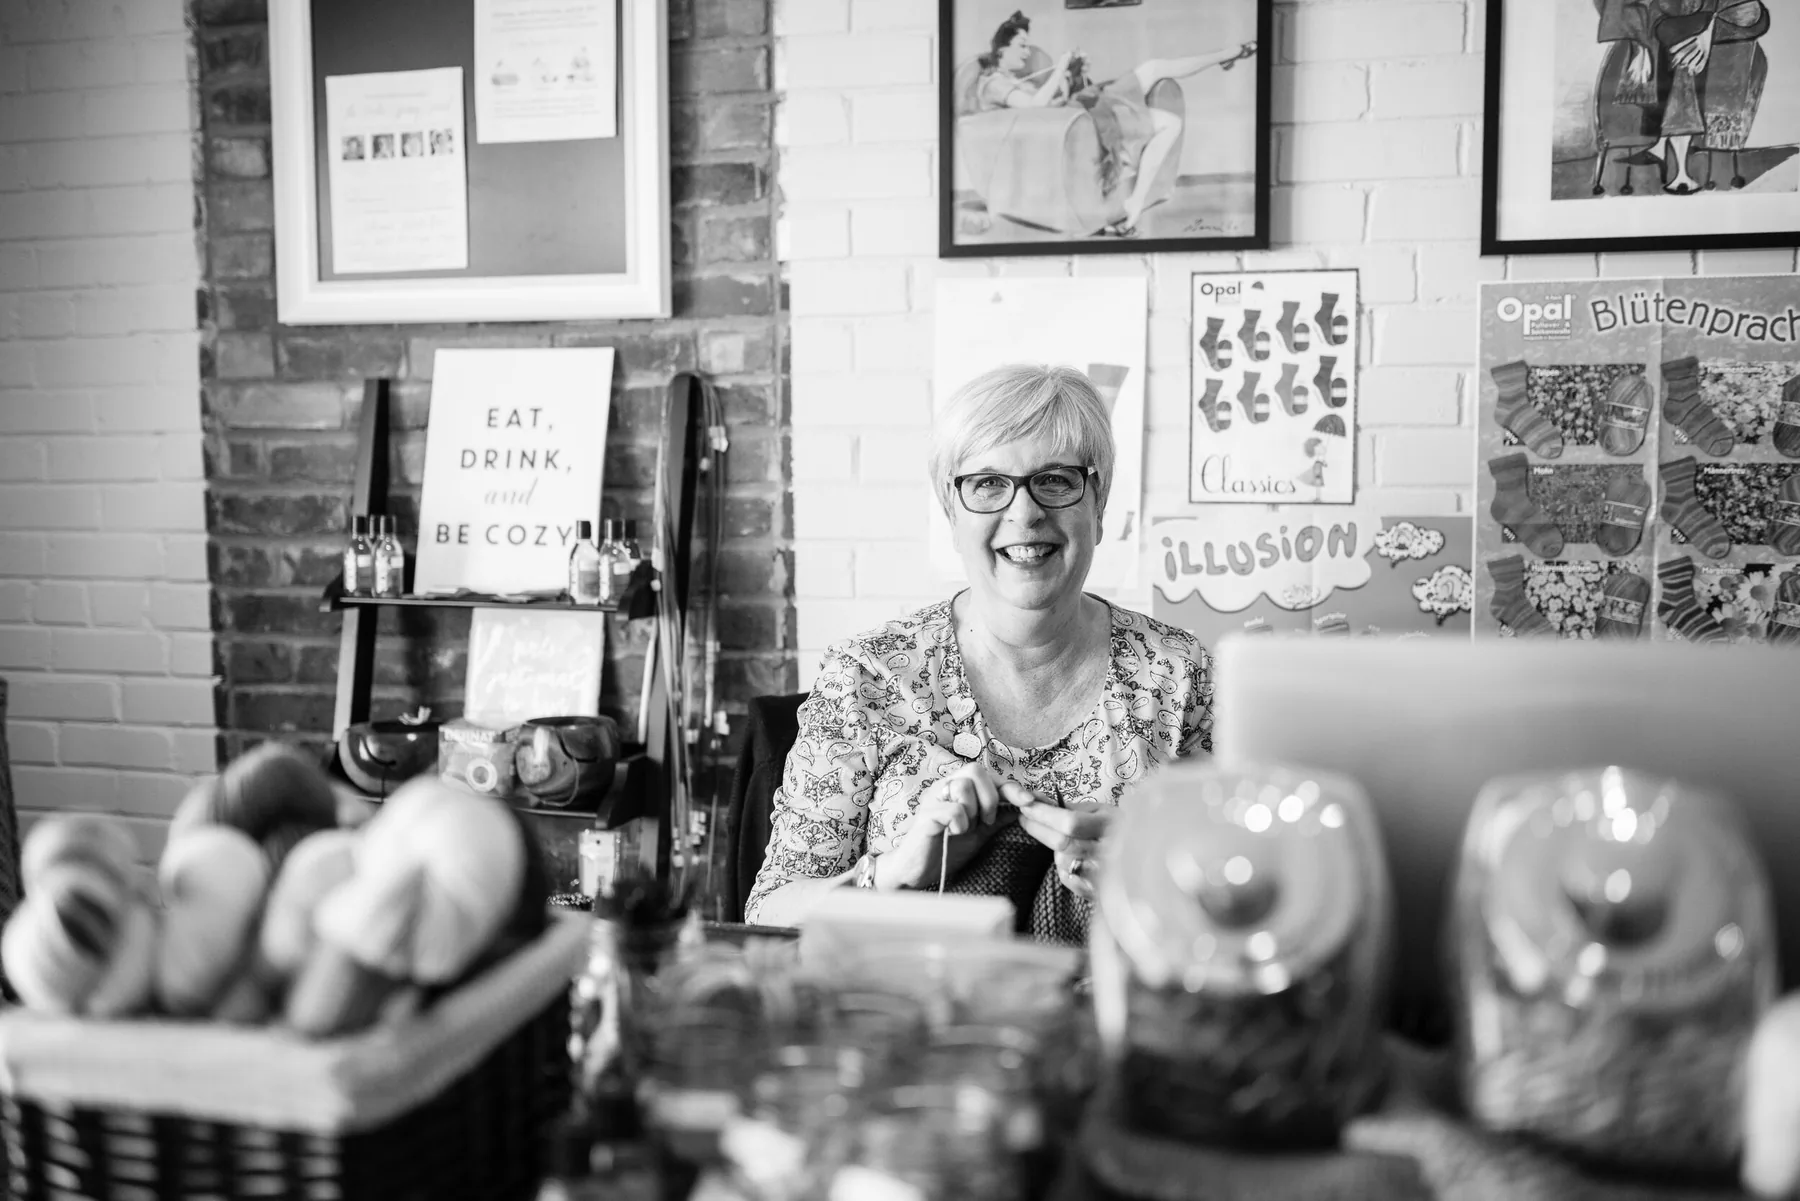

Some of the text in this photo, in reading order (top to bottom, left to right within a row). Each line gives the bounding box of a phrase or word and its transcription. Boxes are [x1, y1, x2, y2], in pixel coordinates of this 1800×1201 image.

[1200, 281, 1241, 303] Opal
[1497, 294, 1571, 335] Opal
[487, 408, 553, 431] EAT,
[460, 449, 571, 473] DRINK,
[1197, 454, 1296, 494] Classics
[484, 477, 538, 505] and
[436, 523, 572, 546] BE COZY
